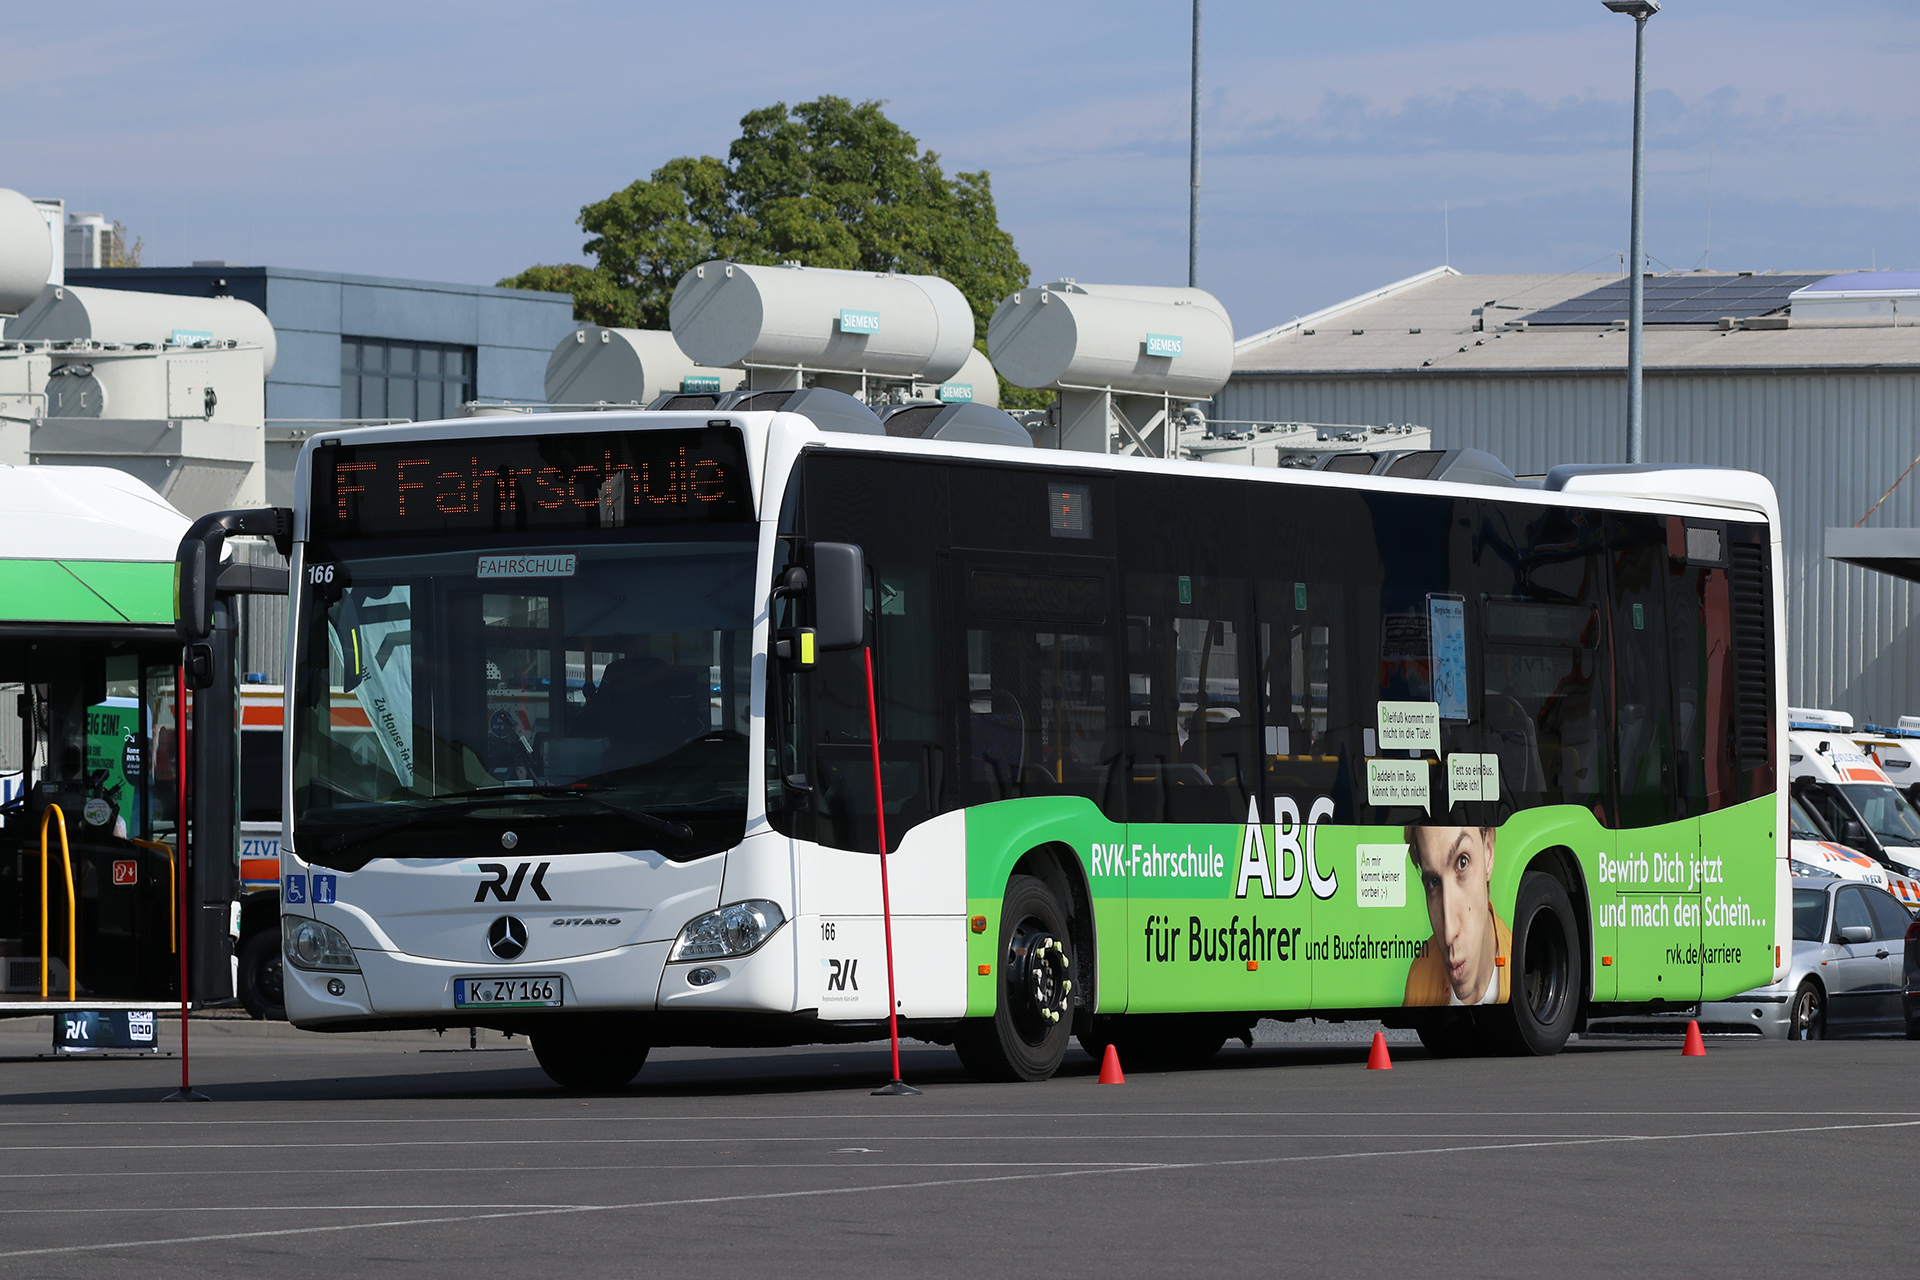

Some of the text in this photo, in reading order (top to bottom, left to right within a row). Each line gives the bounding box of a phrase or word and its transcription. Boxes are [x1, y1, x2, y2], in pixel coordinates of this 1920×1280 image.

[843, 314, 879, 330] SIEMENS
[1149, 338, 1182, 353] SIEMENS
[687, 379, 719, 391] SIEMENS
[942, 386, 972, 399] SIEMENS
[337, 446, 724, 518] F Fahrschule
[308, 564, 334, 585] 166
[479, 557, 574, 575] FAHRSCHULE
[1382, 706, 1434, 724] Bleifuß kommt mir
[101, 714, 120, 736] EIN!
[374, 697, 385, 712] Zu
[382, 712, 404, 748] Hause
[400, 748, 410, 760] in
[1383, 728, 1431, 739] nicht in die Tüte!
[1371, 764, 1416, 781] Daddeln im Bus
[1452, 759, 1494, 776] Fett so ein Bus.
[1372, 785, 1427, 799] könnt ihr, ich nicht!
[1452, 779, 1480, 791] Liebe ich!
[242, 840, 279, 856] ZIVI
[1235, 793, 1338, 901] ABC
[1091, 843, 1225, 878] RVK-Fahrschule
[1360, 850, 1381, 866] An mir
[1360, 870, 1400, 882] kommt keiner
[1598, 851, 1723, 891] Bewirb Dich jetzt
[473, 862, 552, 902] RVK
[1360, 885, 1379, 898] vorbei
[1599, 896, 1767, 928] und mach den Schein...
[552, 917, 622, 926] CITARO
[820, 922, 836, 941] 166
[1144, 915, 1430, 963] für Busfahrer und Busfahrerinnen
[1666, 943, 1742, 964] rvk.de/karriere
[827, 958, 859, 991] RVK
[471, 982, 483, 1001] K
[520, 980, 553, 1000] 166
[65, 1020, 89, 1039] RVK
